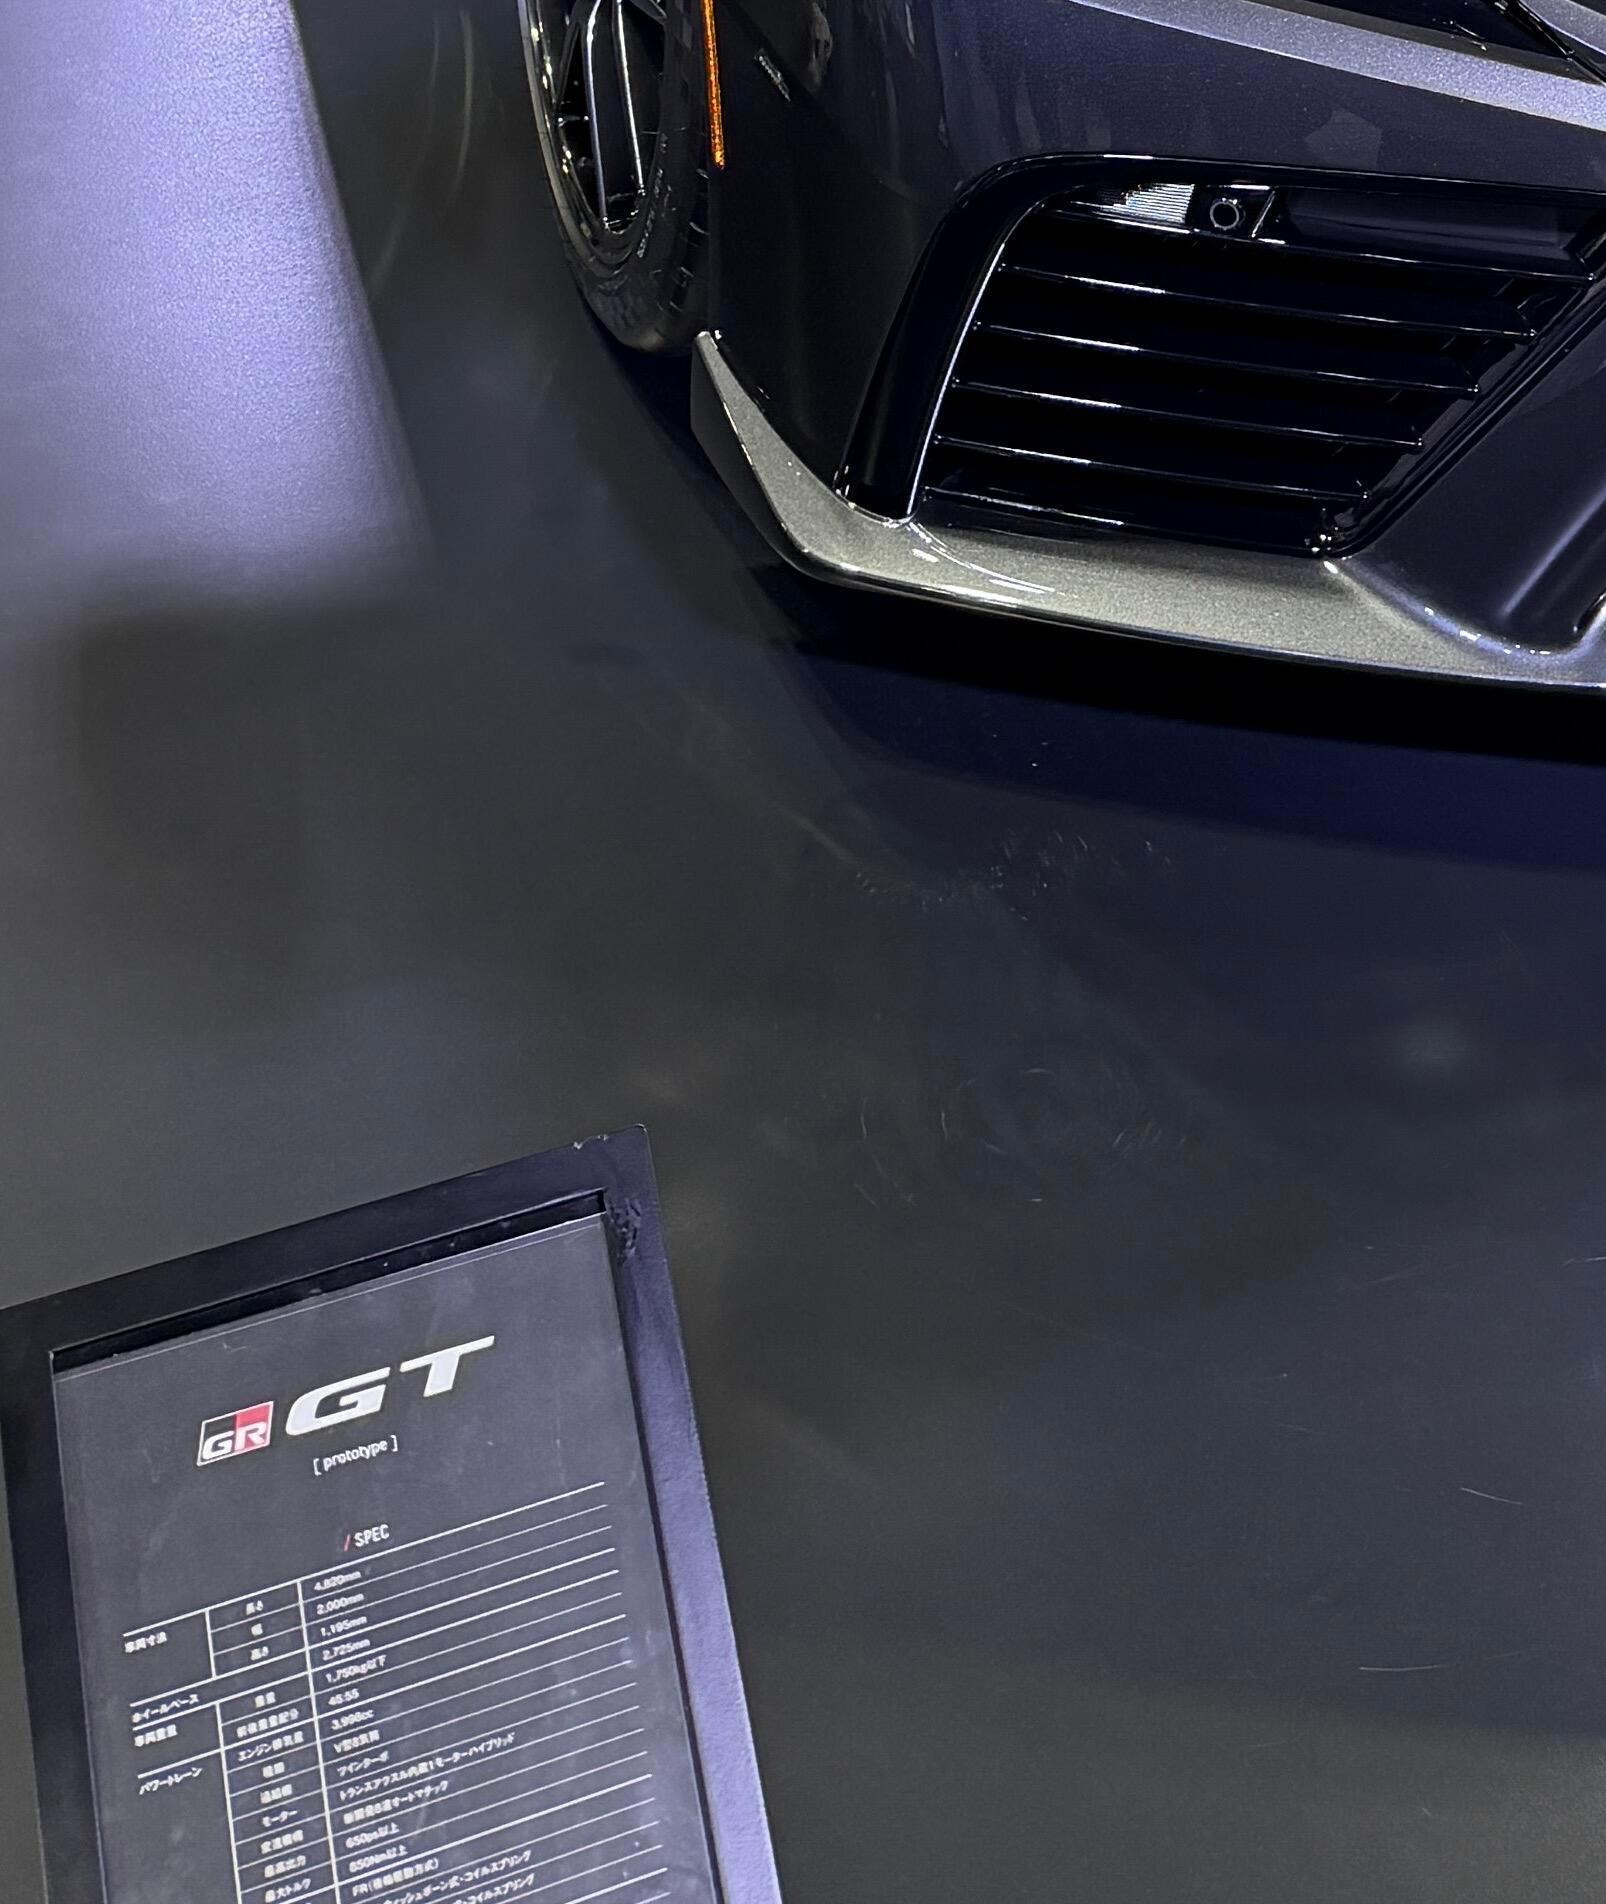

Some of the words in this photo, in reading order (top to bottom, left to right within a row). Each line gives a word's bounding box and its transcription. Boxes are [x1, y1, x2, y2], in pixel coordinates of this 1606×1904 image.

[285, 1335, 494, 1437] GT
[322, 1438, 388, 1473] prototype
[354, 1523, 390, 1548] SPEC
